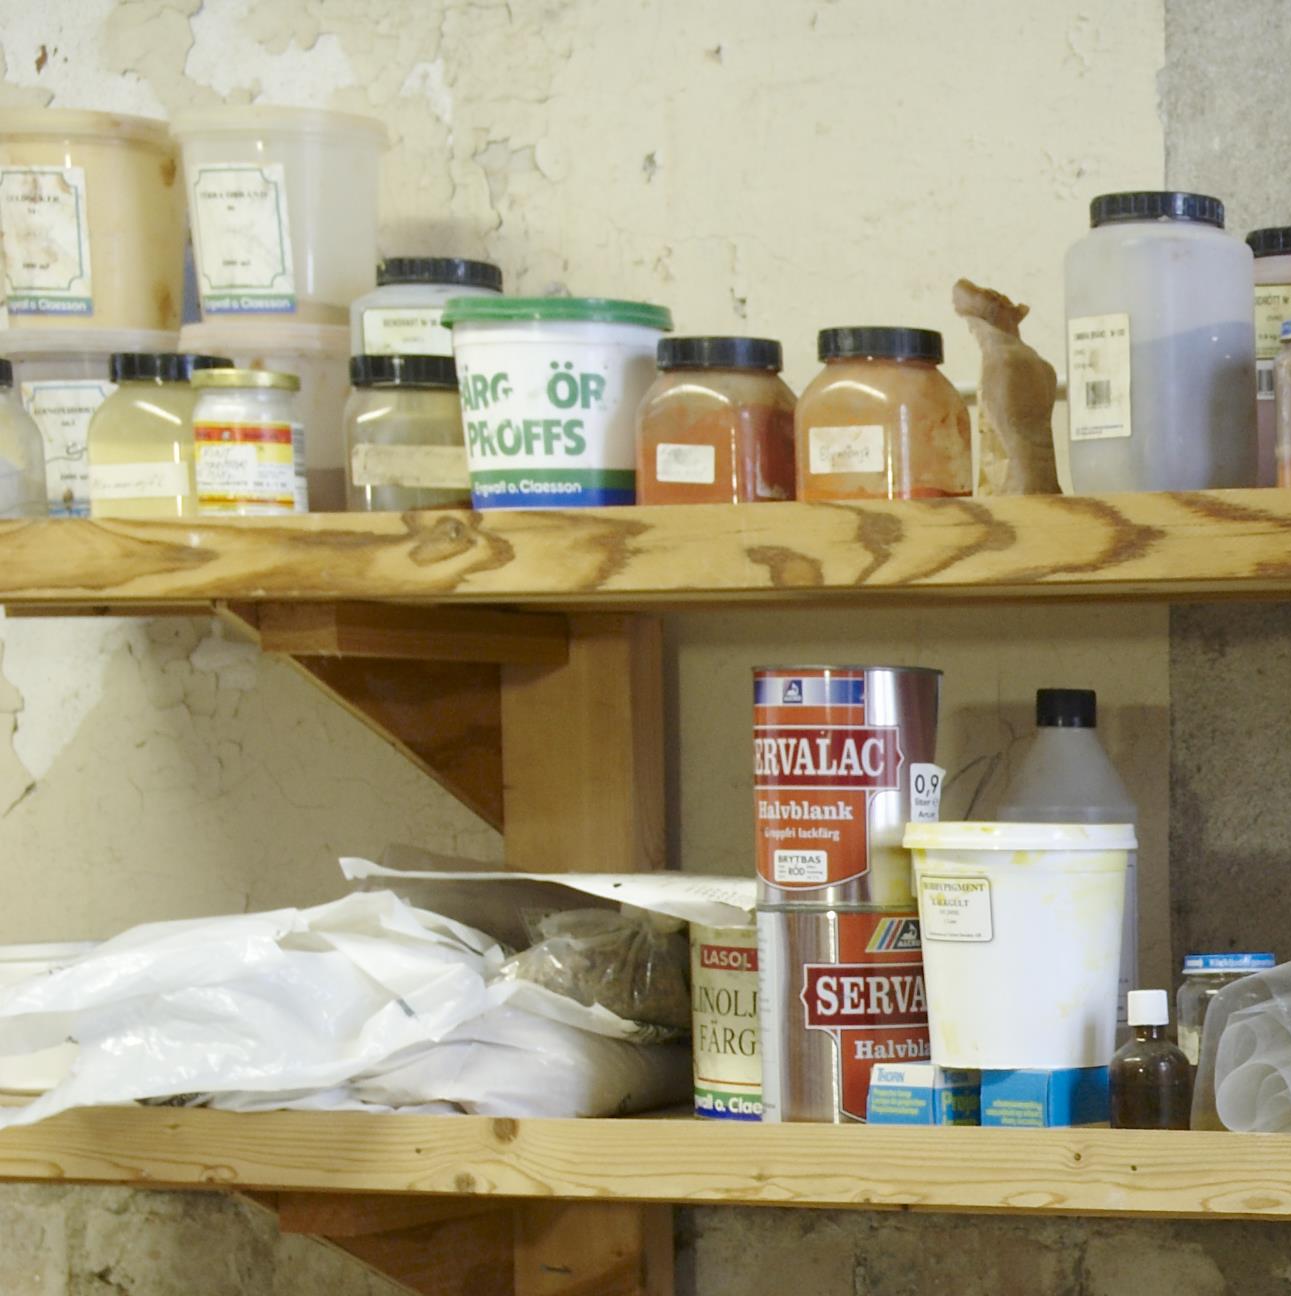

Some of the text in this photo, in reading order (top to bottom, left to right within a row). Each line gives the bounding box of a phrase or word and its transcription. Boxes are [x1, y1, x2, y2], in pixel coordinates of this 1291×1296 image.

[547, 361, 606, 410] ÖR
[467, 418, 586, 457] PROFFS
[519, 479, 582, 494] Claesson
[755, 737, 885, 777] ERVALAC
[758, 801, 854, 820] Halvblank
[798, 827, 841, 842] lackfärg
[777, 855, 822, 864] BRYTBAS
[703, 949, 752, 968] LASOL
[815, 974, 928, 1017] SERVA
[700, 1019, 756, 1057] FÄRG
[855, 1039, 931, 1060] Halvbla
[728, 1097, 763, 1115] Clae
